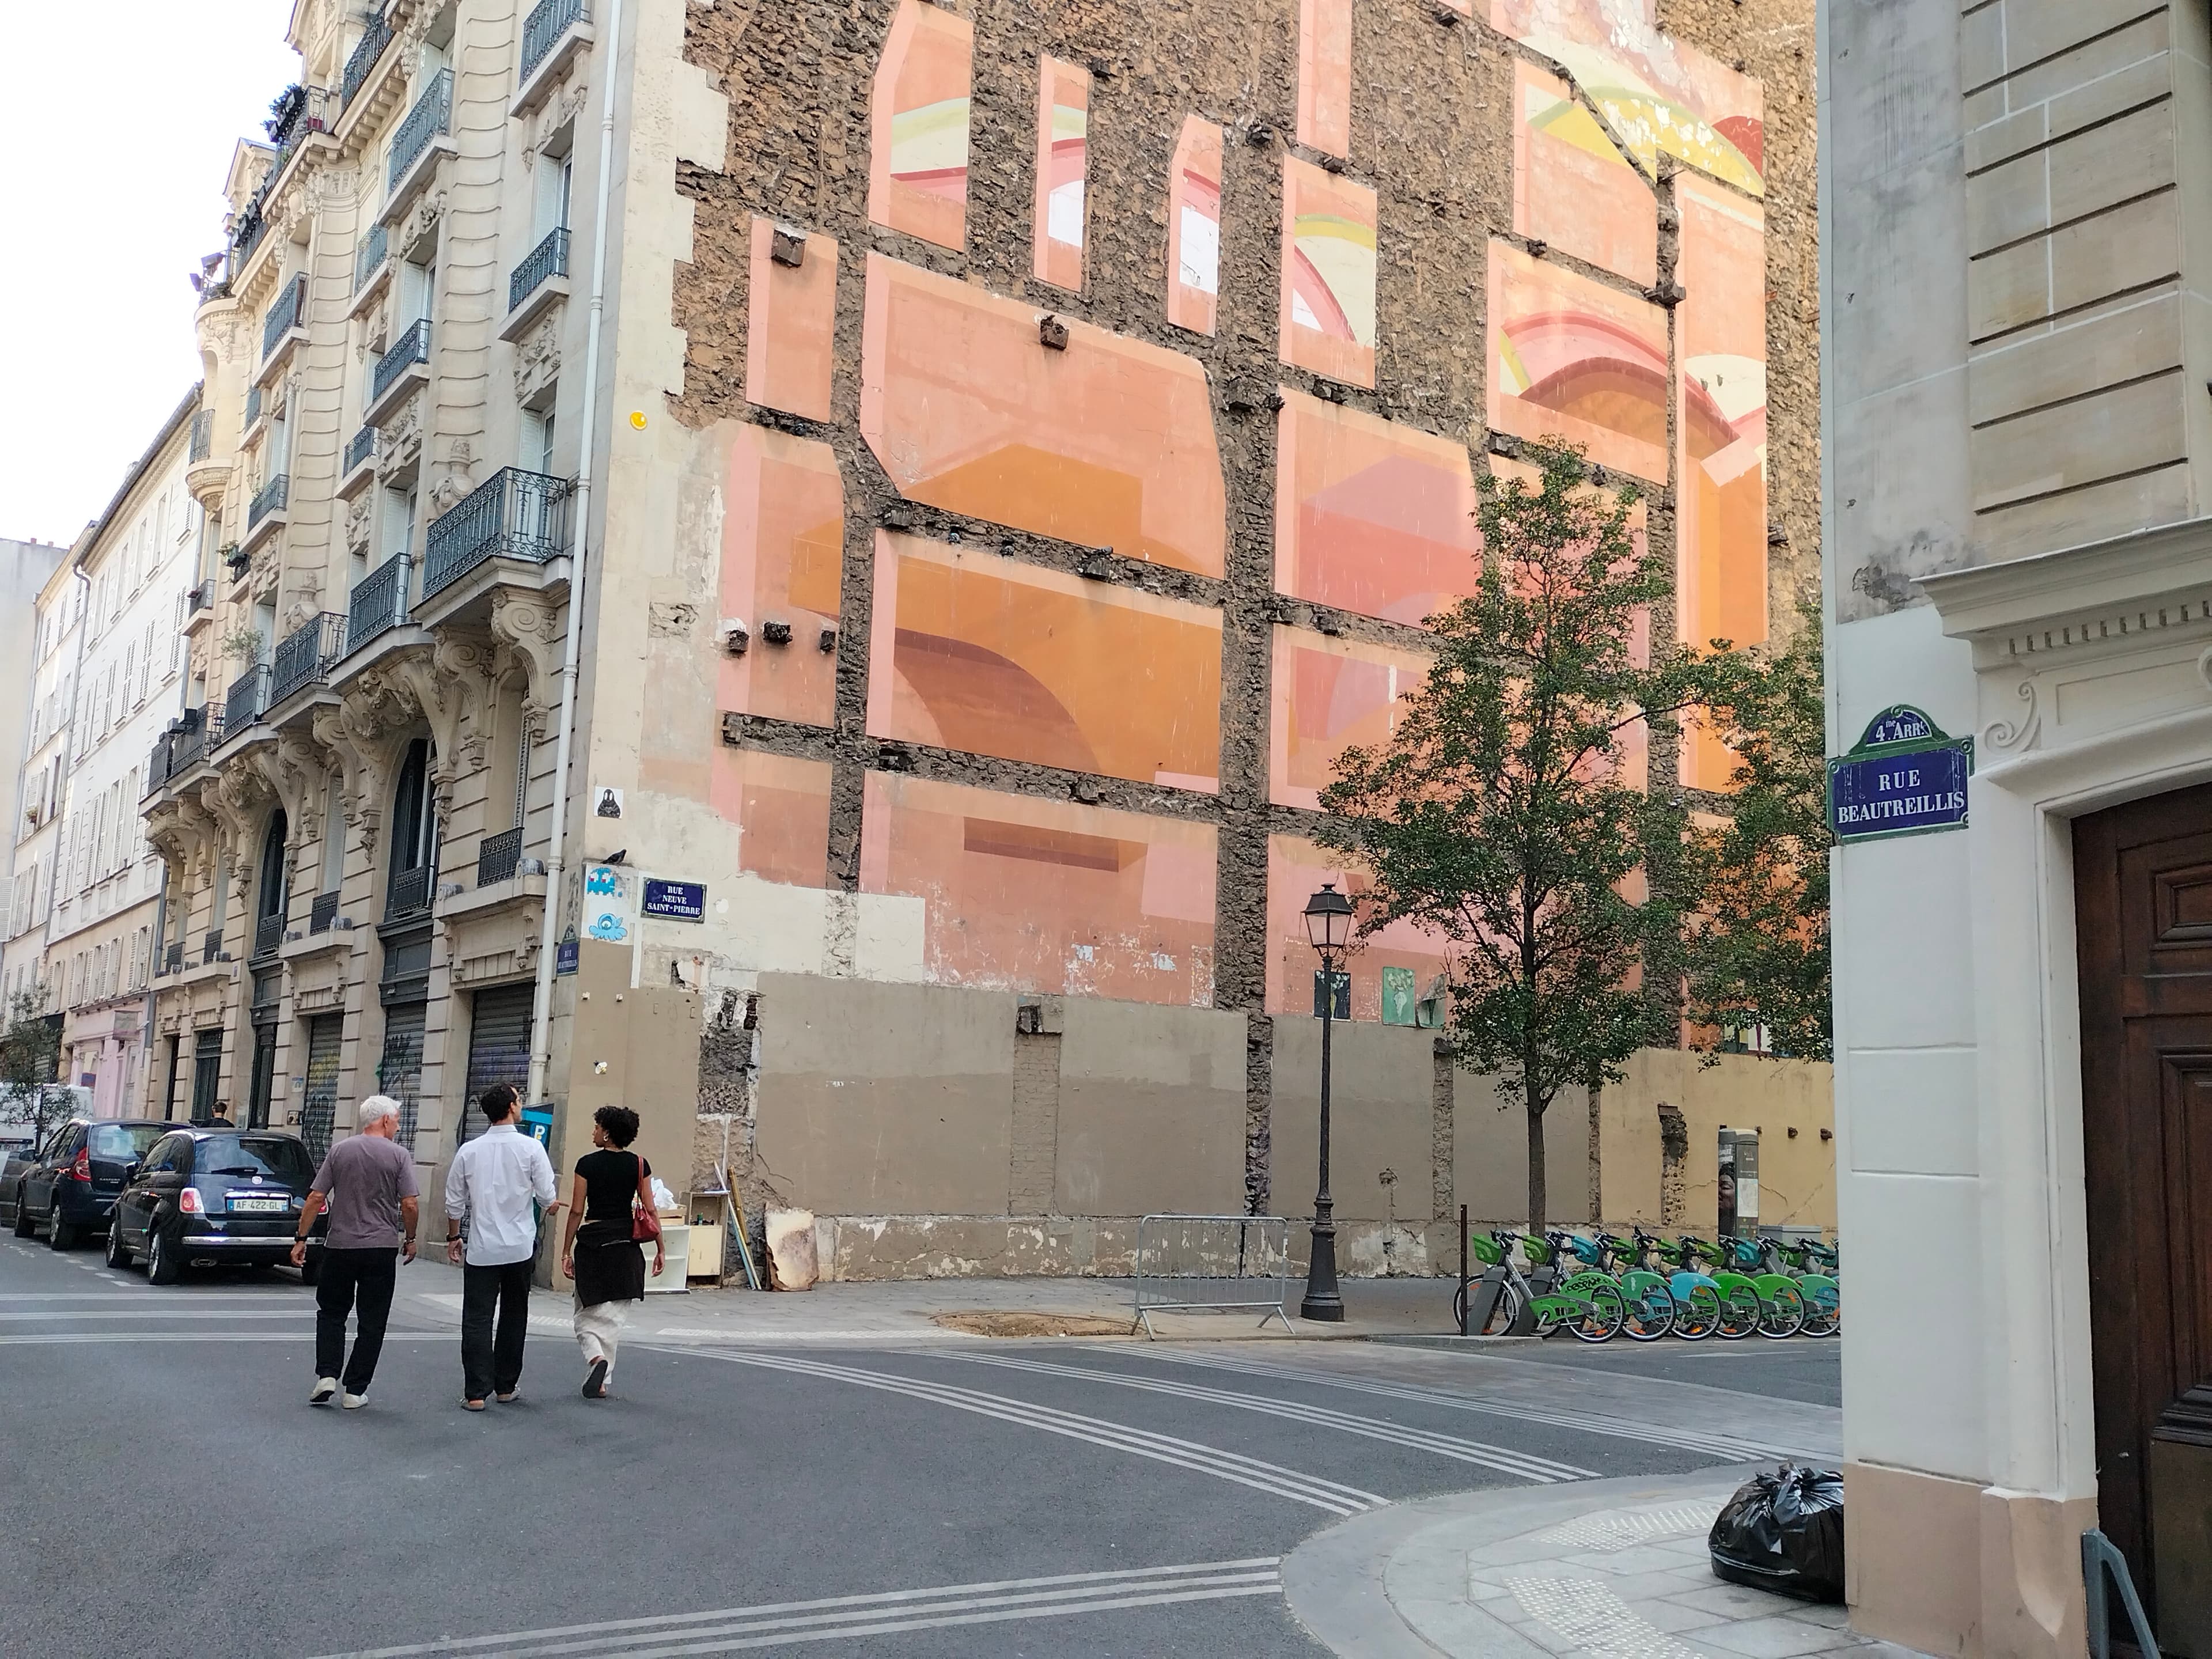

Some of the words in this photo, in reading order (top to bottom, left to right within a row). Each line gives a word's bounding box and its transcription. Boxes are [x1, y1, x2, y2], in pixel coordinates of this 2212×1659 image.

[1878, 770, 1921, 791] RUE
[1838, 791, 1965, 824] BEAUTREILLIS
[667, 885, 683, 895] RUE
[662, 895, 687, 904] NEUVE
[647, 902, 700, 915] SAINT-PIERRE
[535, 1124, 546, 1140] P
